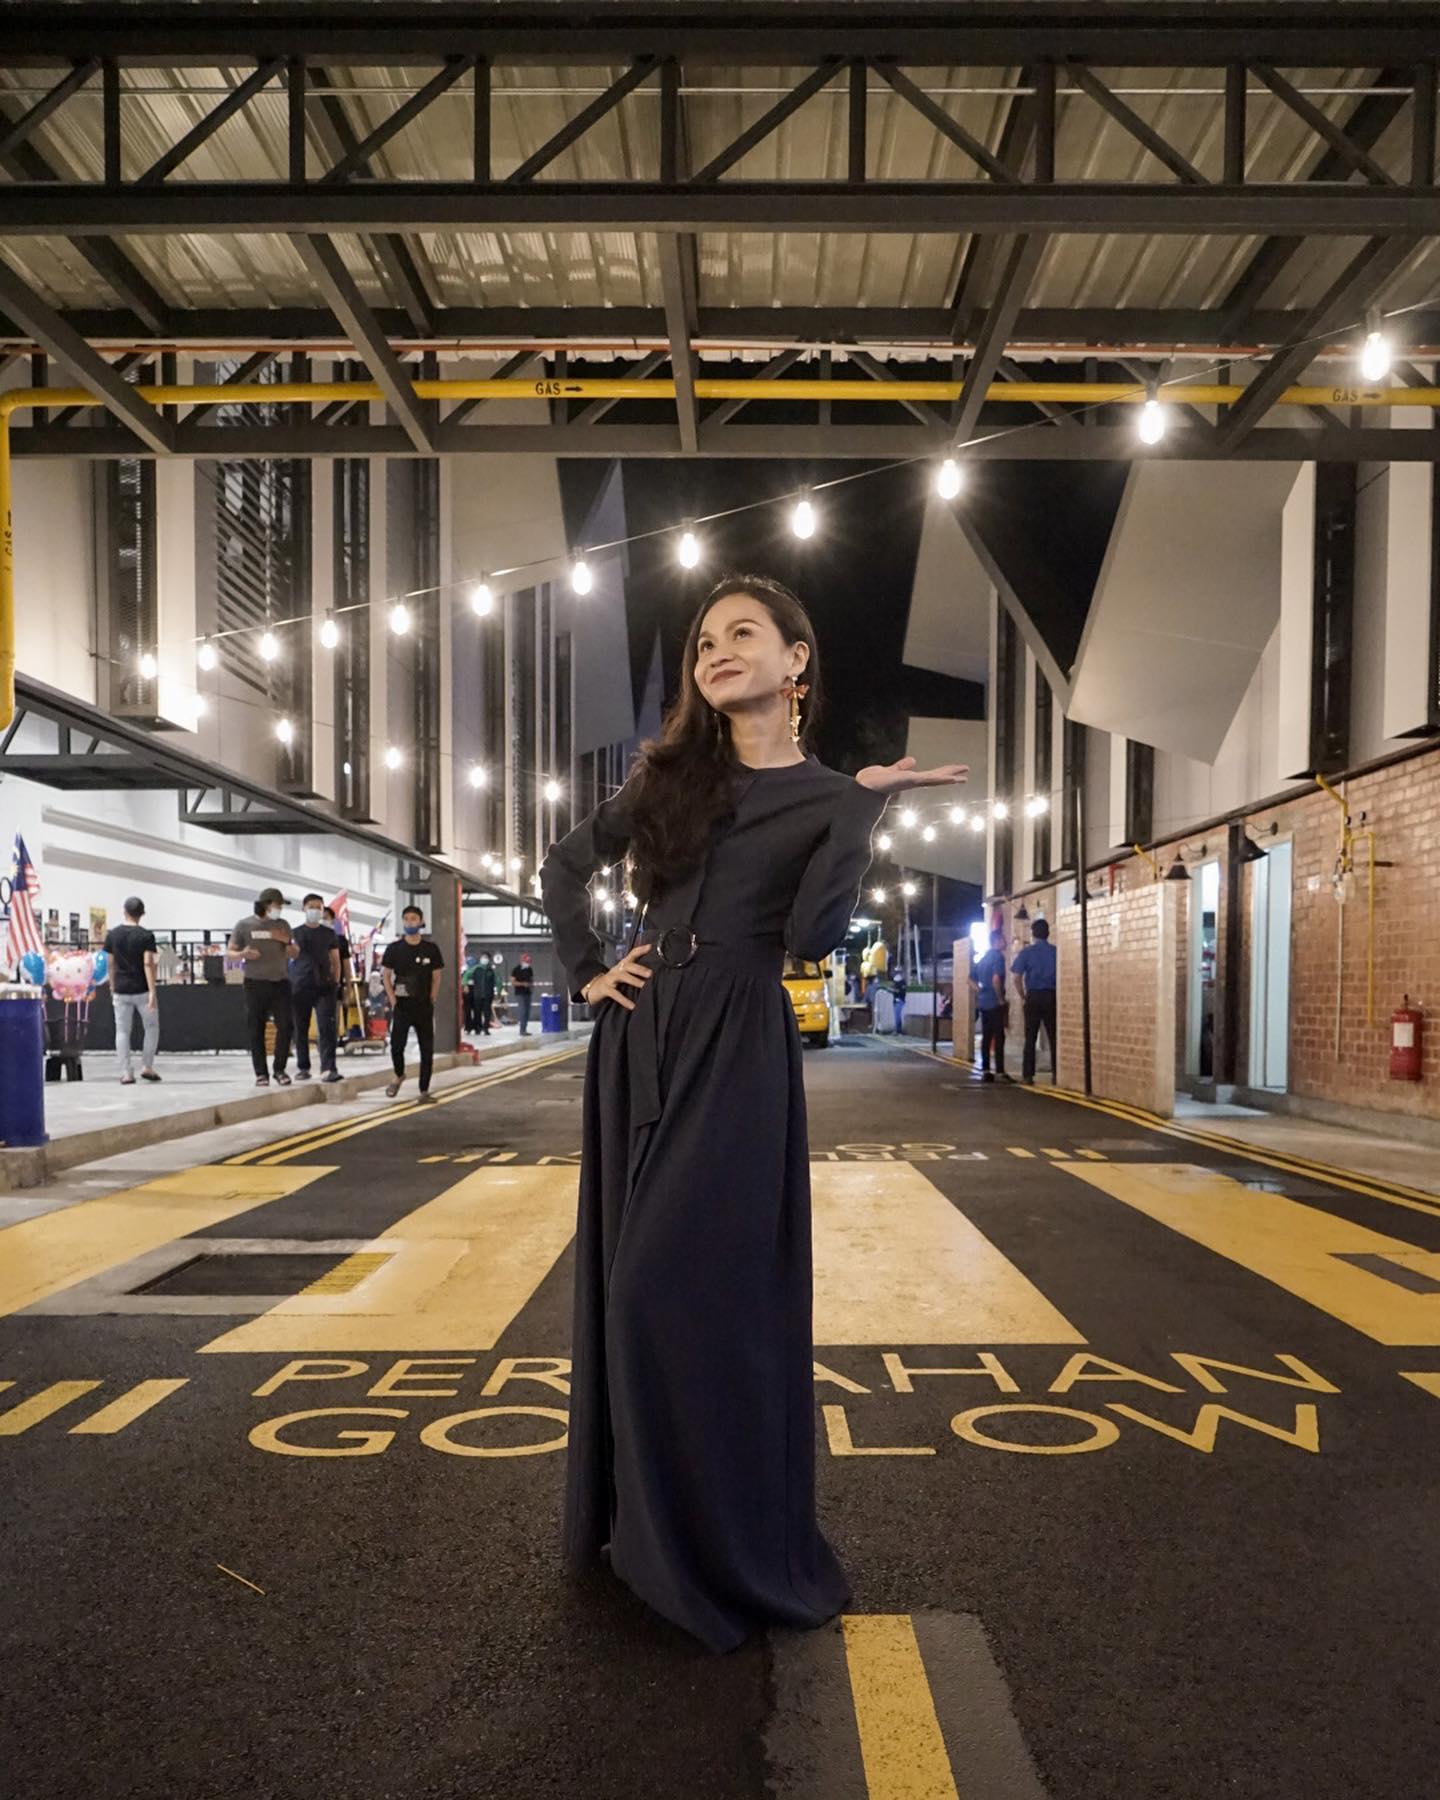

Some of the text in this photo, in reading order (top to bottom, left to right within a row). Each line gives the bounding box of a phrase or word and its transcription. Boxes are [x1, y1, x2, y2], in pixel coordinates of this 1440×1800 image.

[535, 382, 561, 395] GAS
[1332, 388, 1358, 402] GAS
[248, 1403, 1321, 1458] GO LOW
